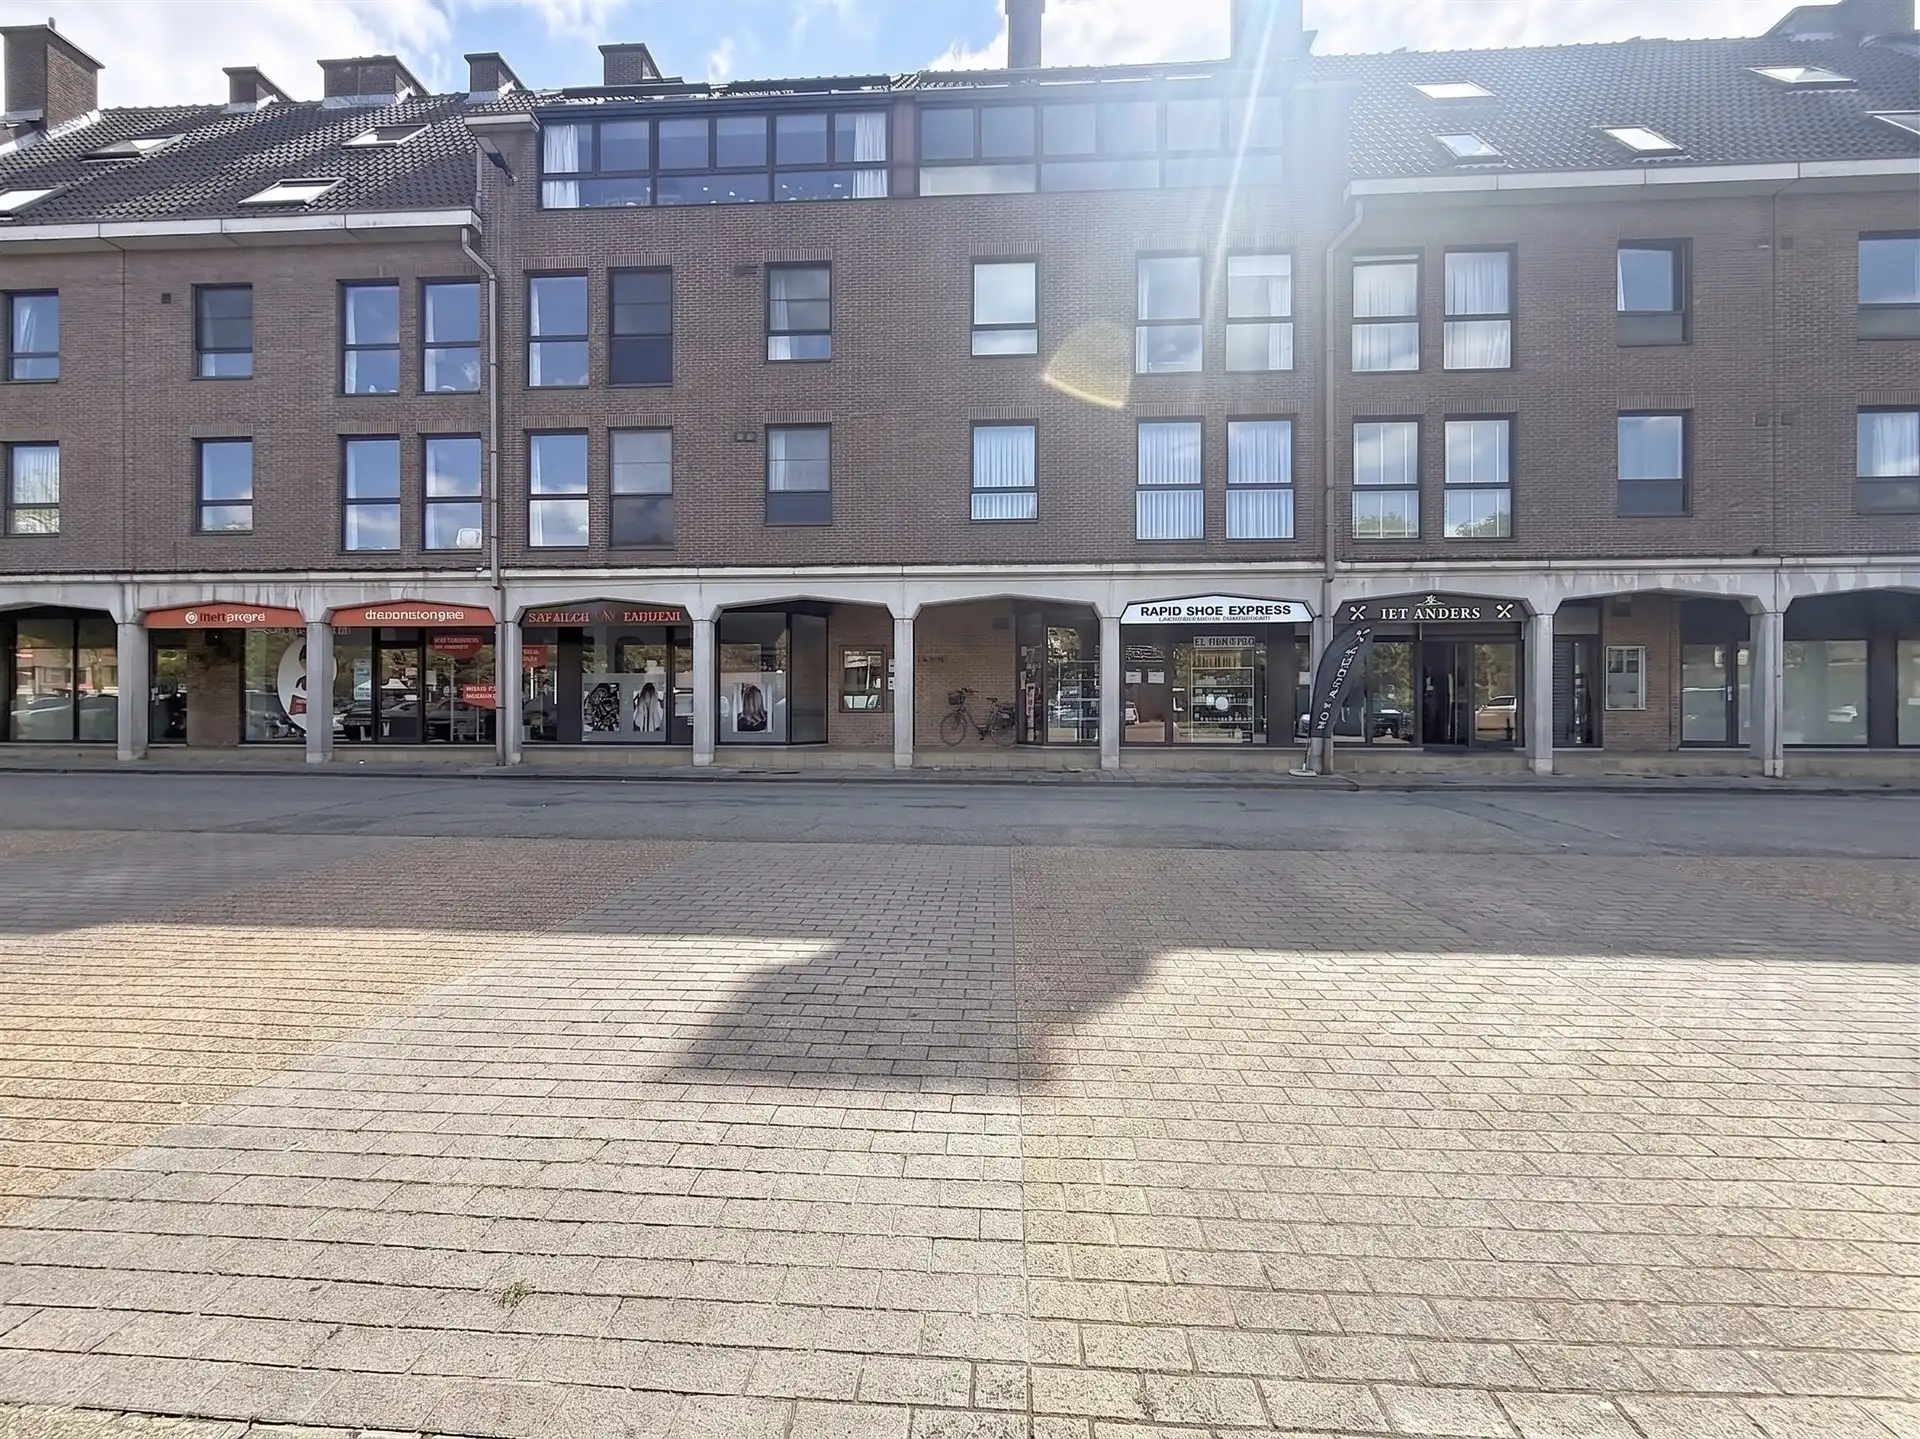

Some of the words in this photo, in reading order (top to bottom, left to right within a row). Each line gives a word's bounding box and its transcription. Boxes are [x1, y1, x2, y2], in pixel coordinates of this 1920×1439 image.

[1140, 606, 1182, 617] RAPID
[1186, 606, 1224, 616] SHOE
[1228, 605, 1292, 616] EXPRESS
[1413, 607, 1481, 620] ANDERS
